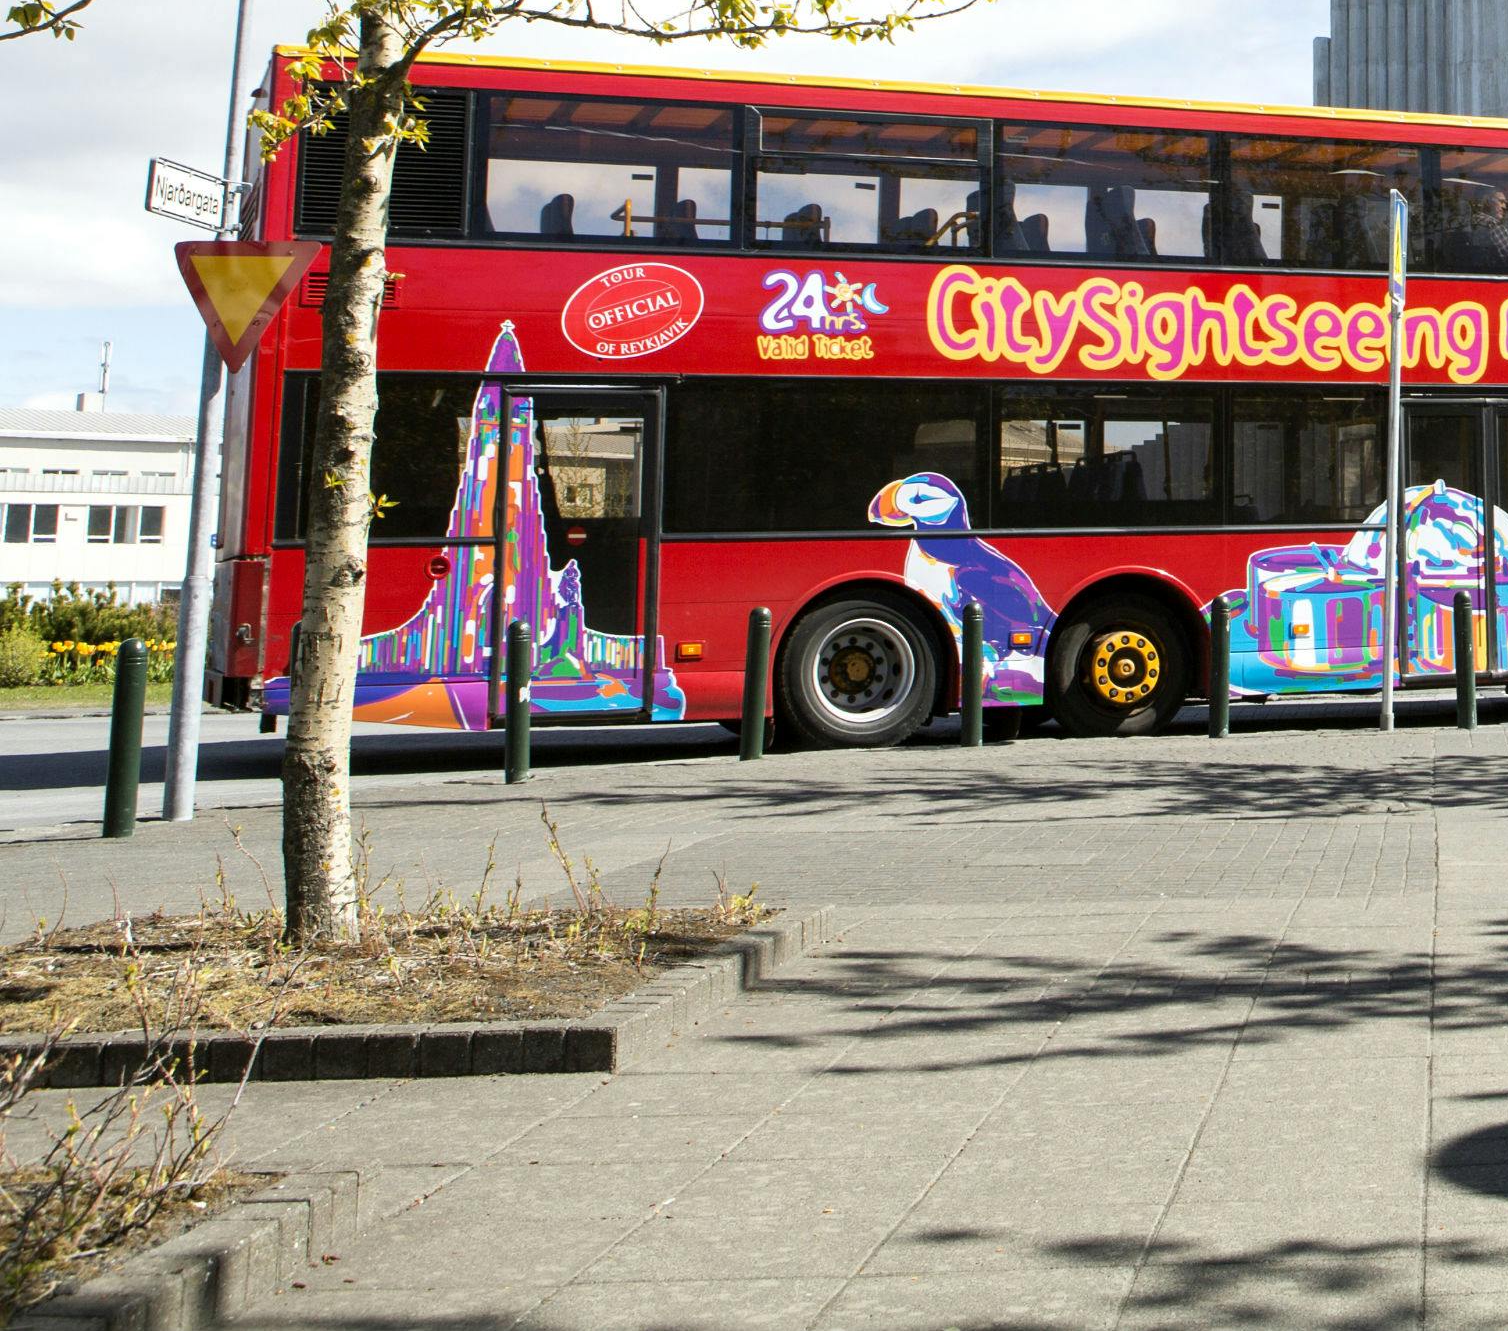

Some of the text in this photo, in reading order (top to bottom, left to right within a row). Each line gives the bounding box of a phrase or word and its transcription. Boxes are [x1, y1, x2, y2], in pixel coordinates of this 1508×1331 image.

[155, 175, 219, 216] Njarðargata
[601, 267, 646, 288] TOUR
[588, 291, 679, 329] OFFICIAL
[761, 271, 830, 331] 24
[596, 317, 689, 355] OF REYKJAVIK
[928, 265, 1488, 383] CitySightseeng
[757, 334, 875, 360] Valid Ticket
